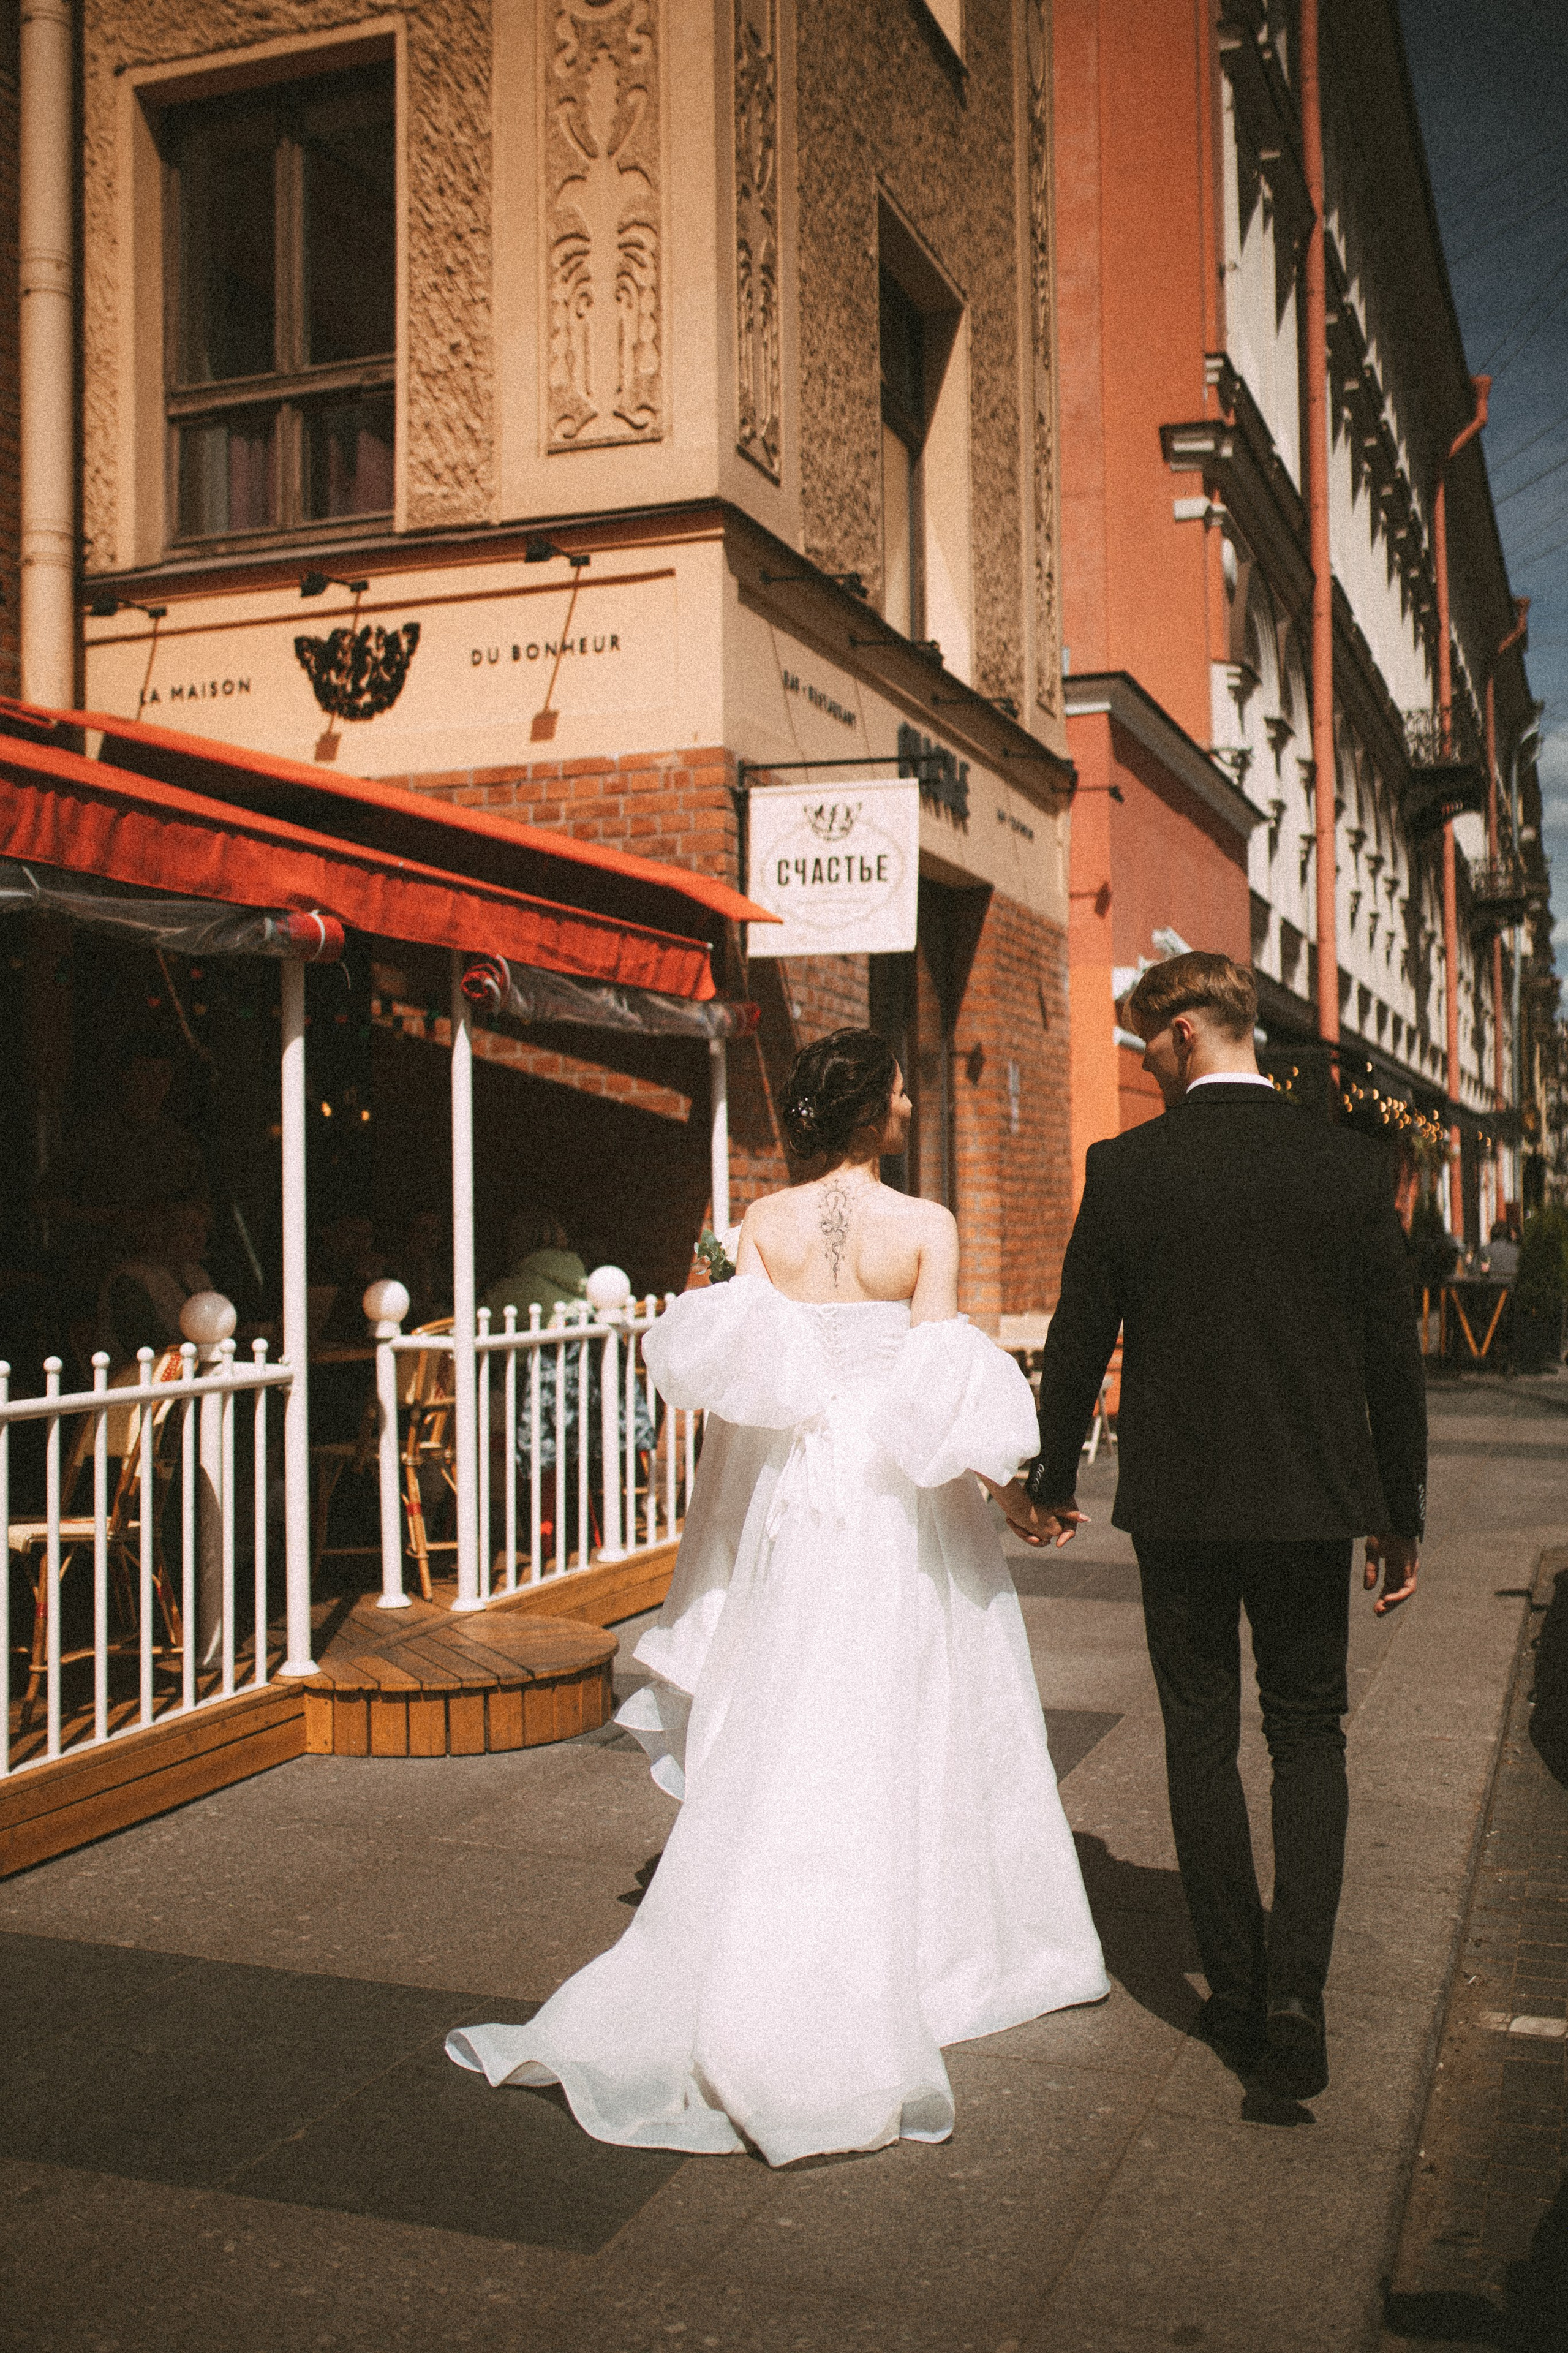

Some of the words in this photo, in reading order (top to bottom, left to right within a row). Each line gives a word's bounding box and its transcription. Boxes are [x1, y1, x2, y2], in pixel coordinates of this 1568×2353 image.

[472, 646, 499, 667] DU
[512, 633, 620, 662] BONHEUR
[140, 687, 161, 705] LA
[171, 678, 252, 702] MAISON
[777, 854, 888, 886] СЧАСТЬЕ
